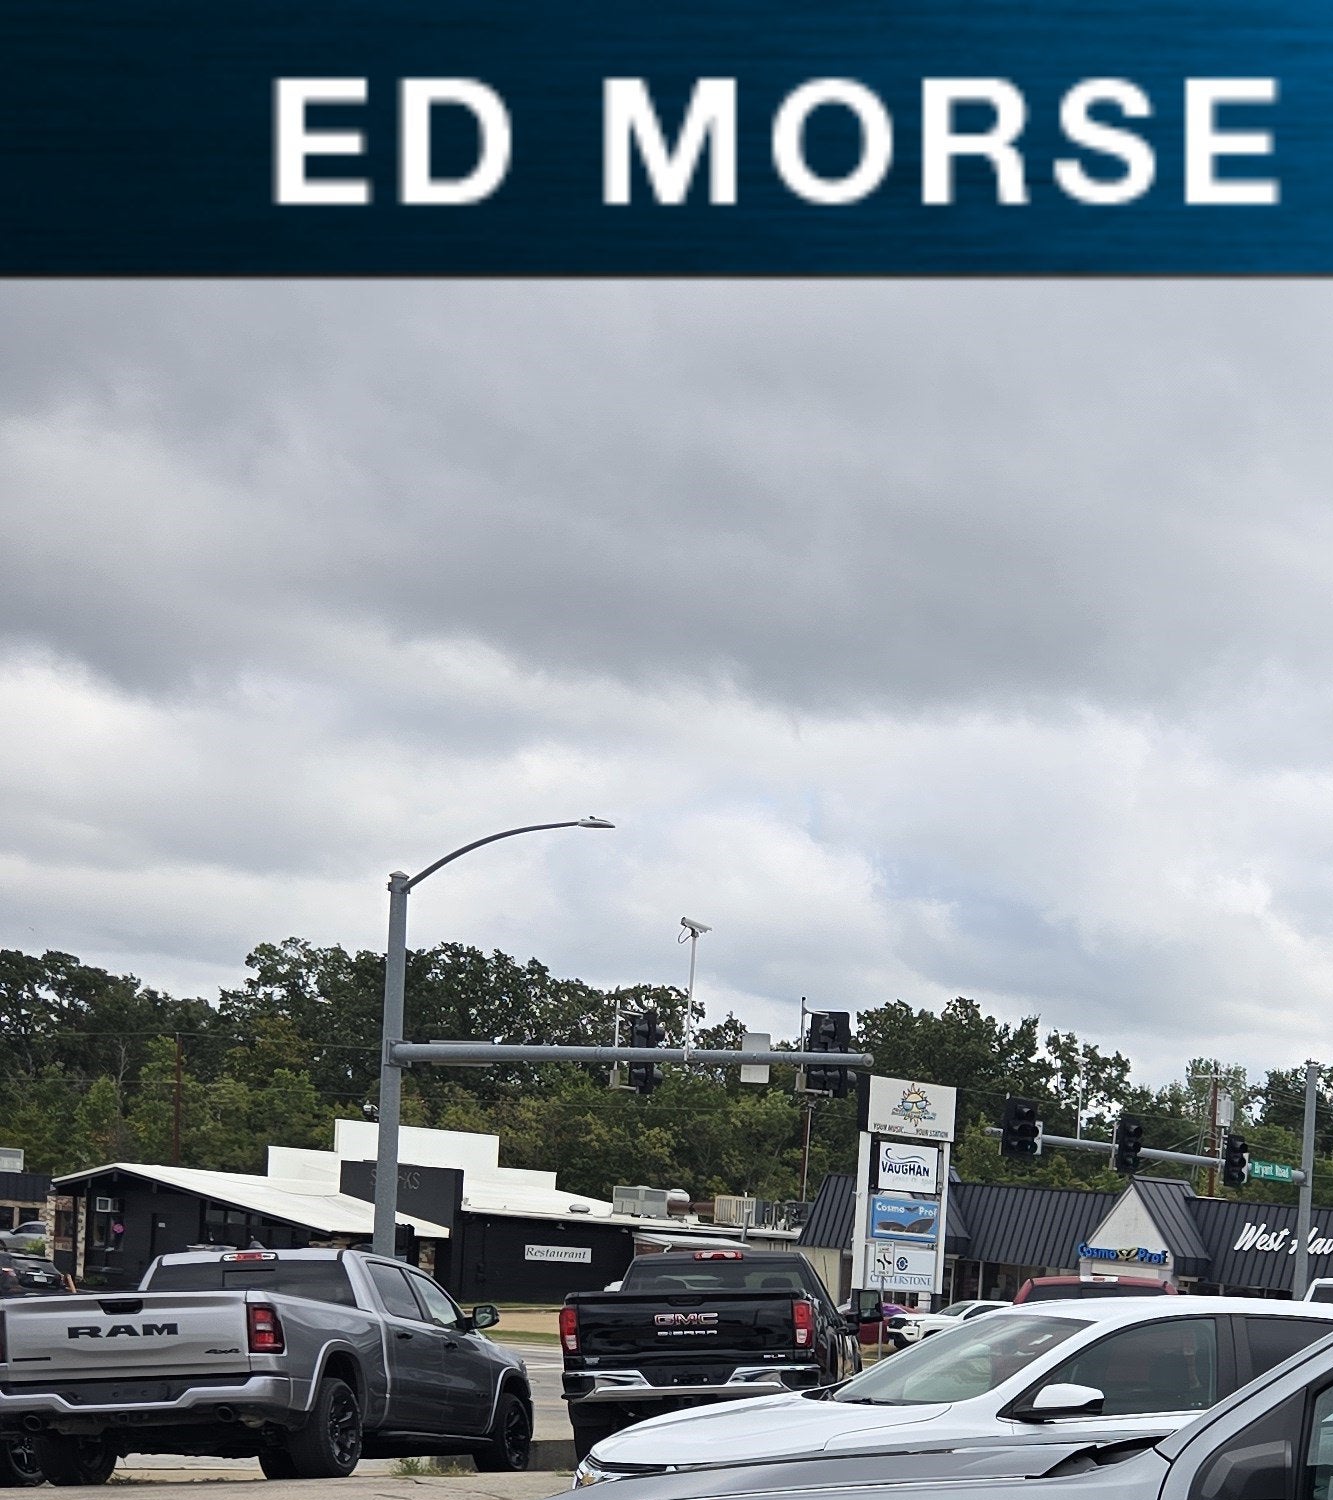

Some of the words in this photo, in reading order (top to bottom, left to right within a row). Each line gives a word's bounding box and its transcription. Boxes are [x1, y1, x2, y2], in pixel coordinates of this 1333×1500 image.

[881, 1160, 930, 1178] VAUGHAN
[876, 1201, 905, 1213] Cosmo
[918, 1206, 938, 1217] Prof
[1233, 1222, 1291, 1252] West
[526, 1247, 586, 1259] Restaurant
[1077, 1241, 1117, 1260] Cosmo
[1138, 1247, 1169, 1265] Prof
[653, 1312, 719, 1326] GMC
[67, 1323, 179, 1340] RAM
